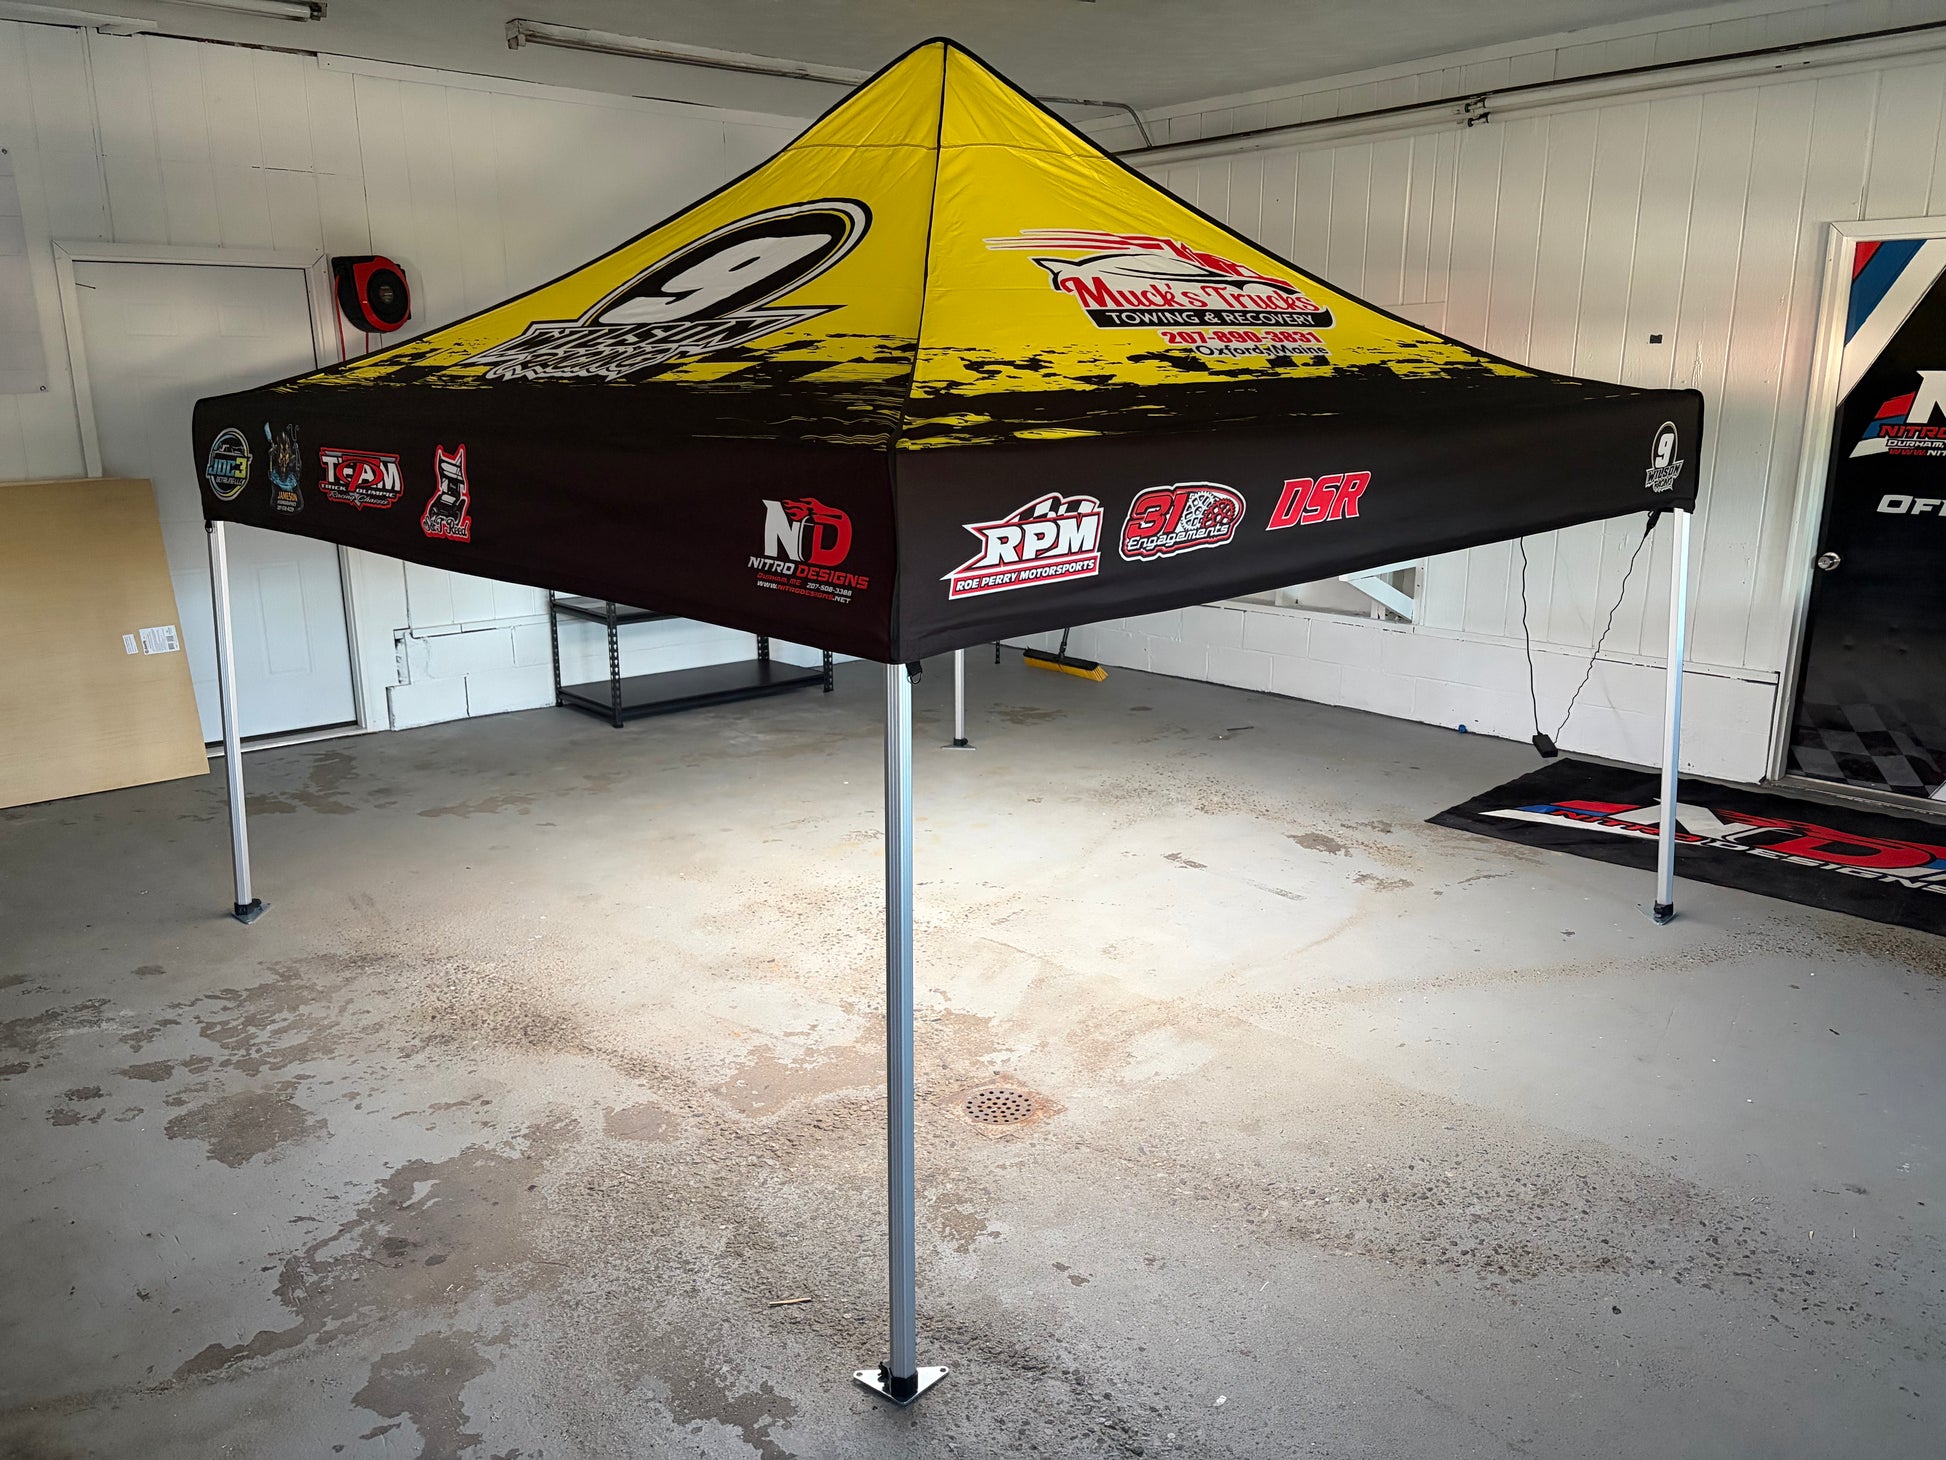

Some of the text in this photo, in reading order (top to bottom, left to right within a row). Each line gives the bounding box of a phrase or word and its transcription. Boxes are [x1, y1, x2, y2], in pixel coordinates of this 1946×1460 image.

[598, 233, 832, 325] 9
[1060, 276, 1320, 312] Muck's Trucks
[1105, 311, 1315, 325] TOWING & RECOVERY
[1161, 331, 1323, 344] 207-890-3831
[1195, 344, 1329, 358] Oxford, Maine
[1654, 432, 1675, 468] 9
[1127, 493, 1188, 539] 31
[1265, 470, 1372, 531] DSR
[971, 514, 1099, 568] RPM
[1127, 524, 1229, 550] Engagements
[747, 556, 870, 590] NITRO DESIGNS
[956, 559, 1096, 592] ROE PERRY MOTORSPORTS
